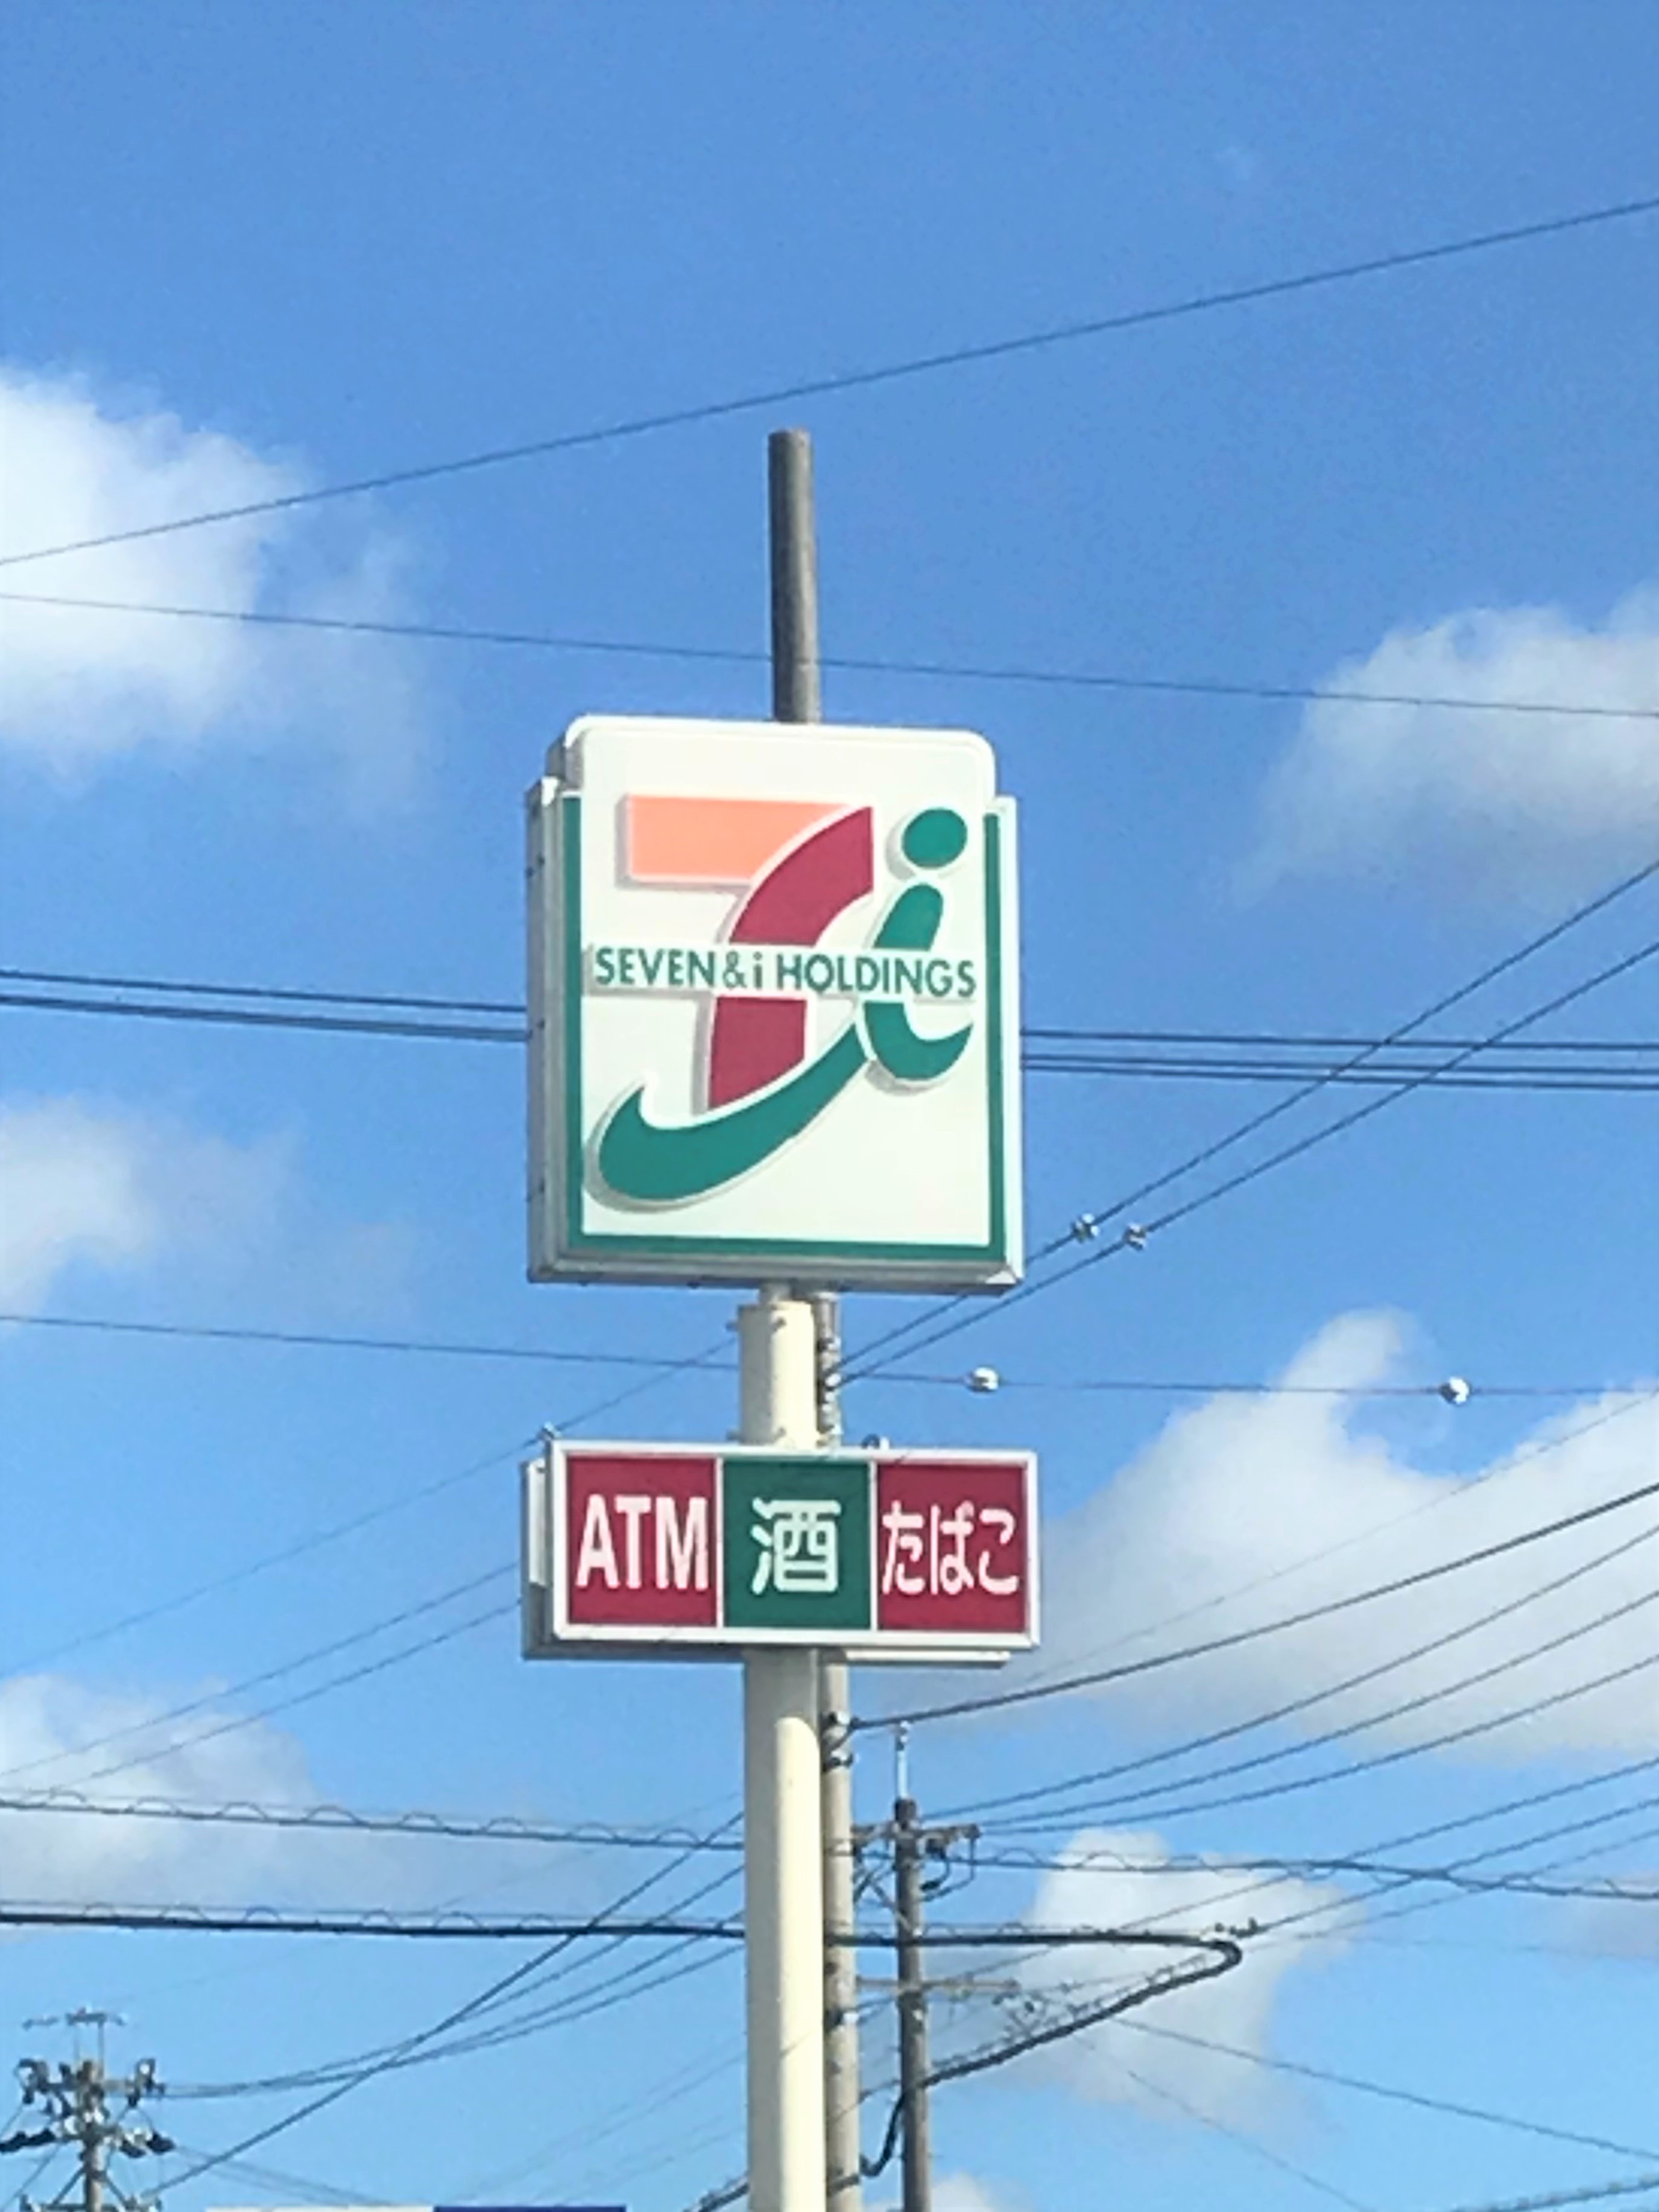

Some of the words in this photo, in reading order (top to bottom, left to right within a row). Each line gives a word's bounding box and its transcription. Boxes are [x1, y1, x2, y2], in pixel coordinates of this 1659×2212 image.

[776, 954, 976, 998] HOLDINGS
[575, 1494, 709, 1592] ATM
[751, 1497, 841, 1595] 酒
[881, 1500, 1020, 1596] たばこ
